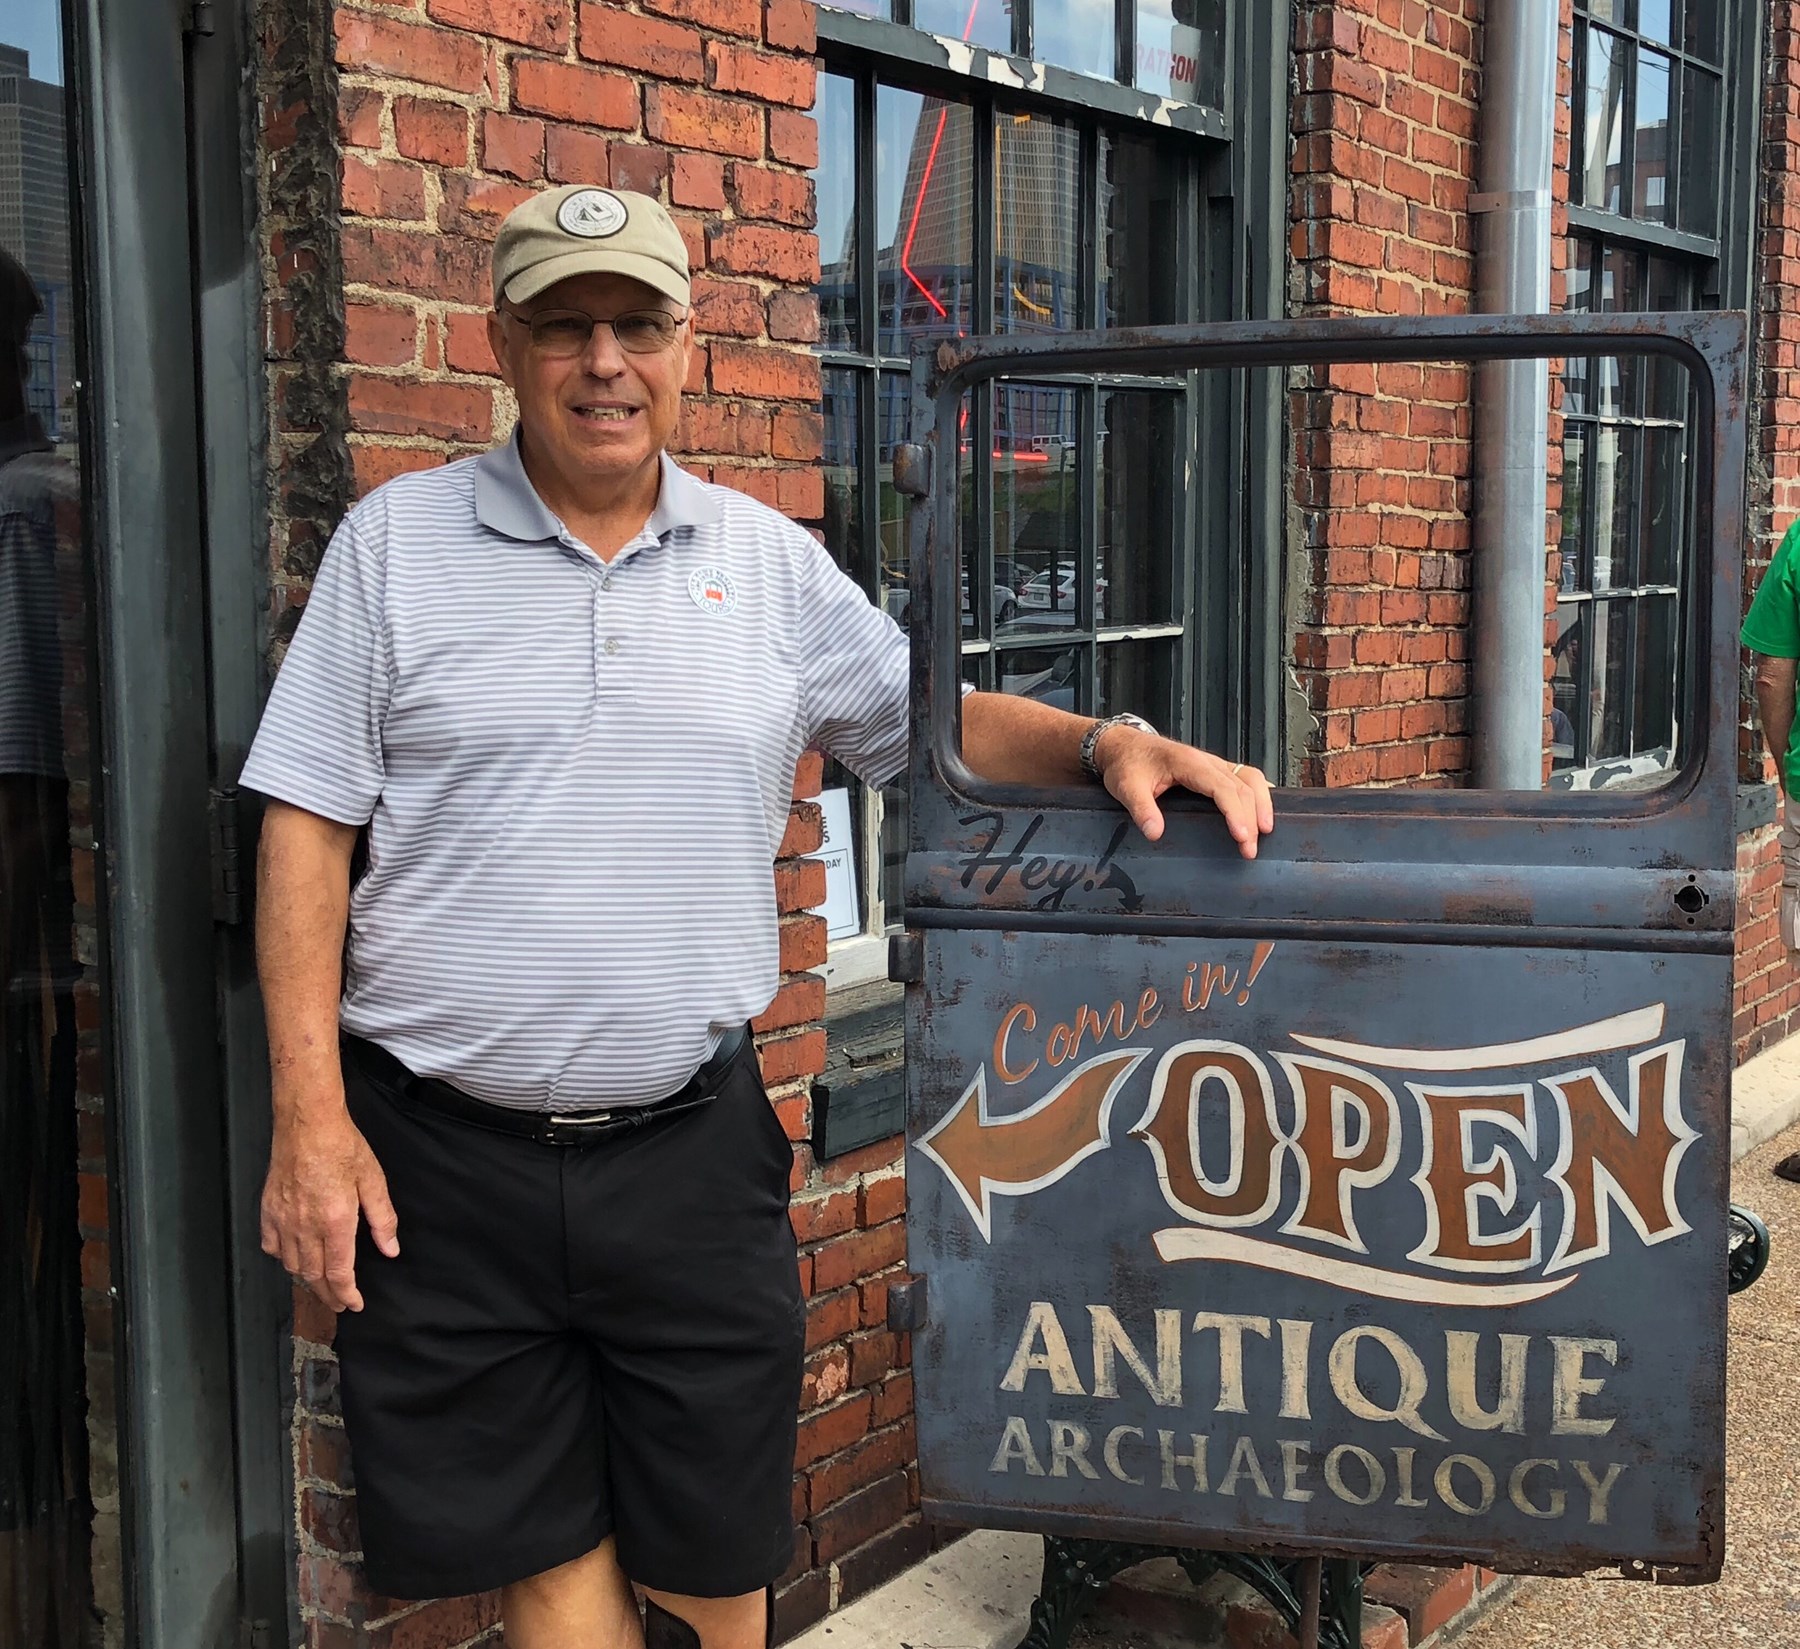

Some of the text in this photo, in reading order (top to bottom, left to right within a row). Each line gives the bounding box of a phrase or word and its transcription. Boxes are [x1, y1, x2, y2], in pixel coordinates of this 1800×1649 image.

[959, 812, 1129, 912] Hey!
[993, 942, 1275, 1085] Come in!
[1126, 1038, 1702, 1275] OPEN
[1000, 1301, 1620, 1441] ANTIQUE
[988, 1415, 1629, 1525] ARCHAEOLOGY
